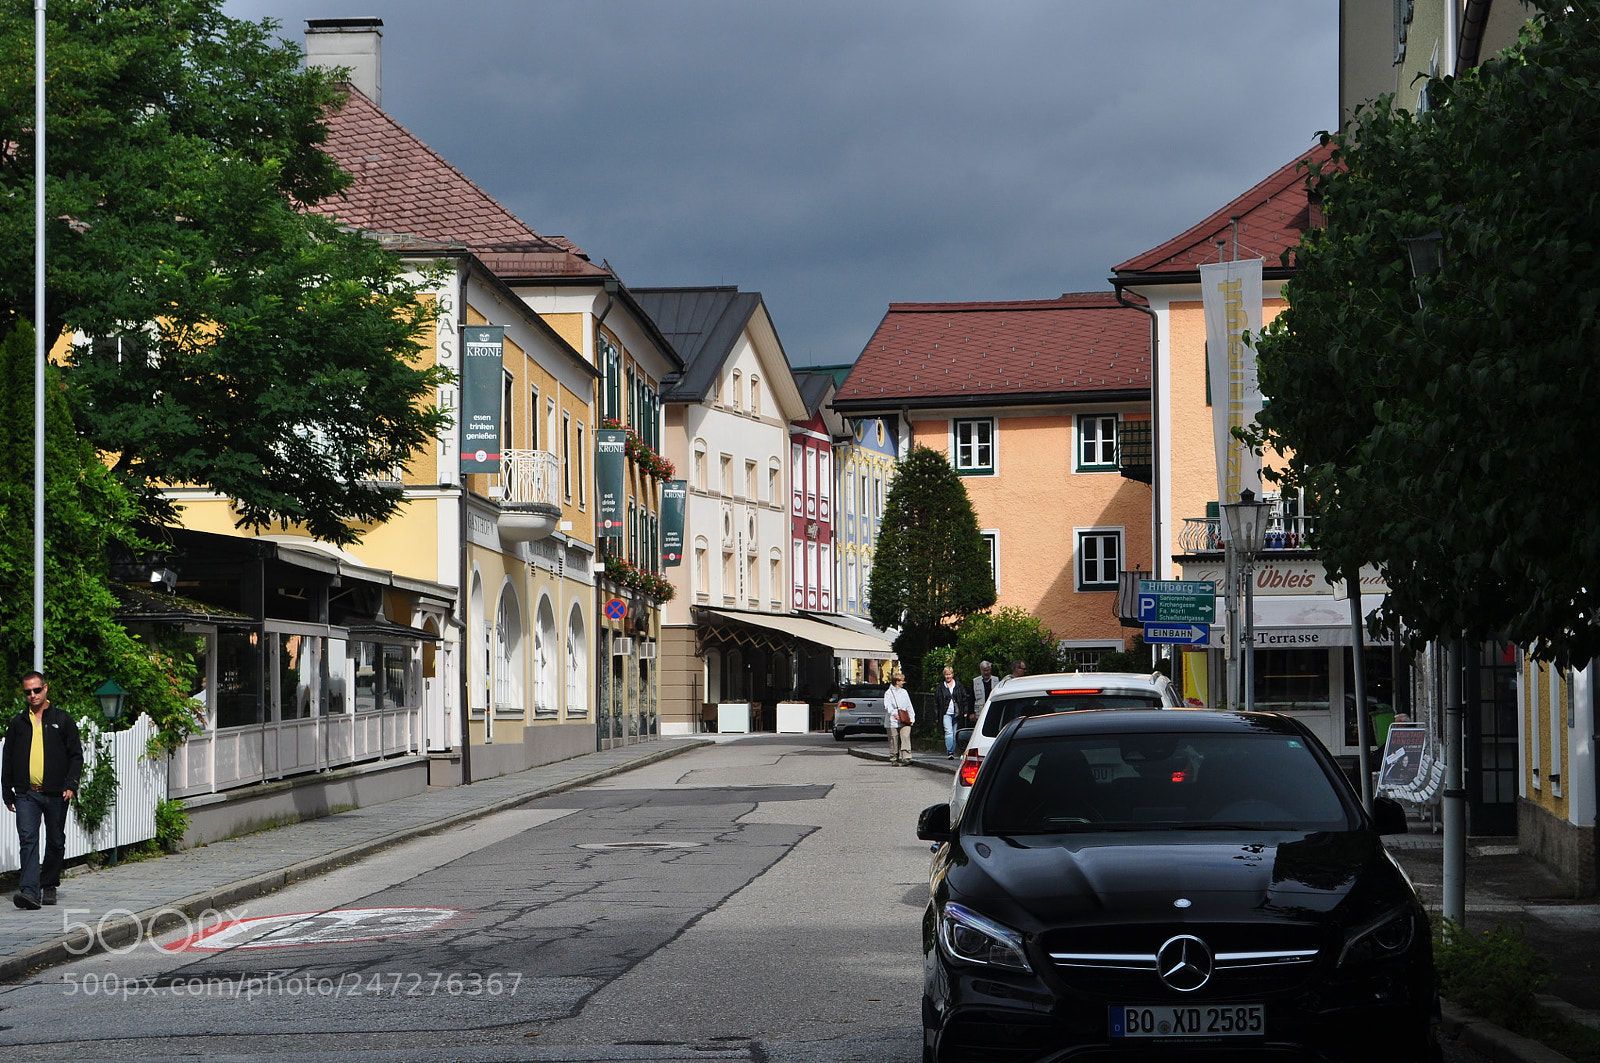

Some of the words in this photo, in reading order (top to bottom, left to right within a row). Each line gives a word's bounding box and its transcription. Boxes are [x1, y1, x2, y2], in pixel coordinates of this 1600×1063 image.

[466, 347, 502, 357] KRONE
[438, 293, 455, 456] GASHOF
[1217, 278, 1248, 503] alzkammergut
[466, 432, 497, 440] genießen
[598, 445, 624, 453] KRONE
[664, 491, 686, 499] KRONE
[1257, 565, 1316, 588] Übleis
[1149, 582, 1193, 593] Hilfberg
[1140, 597, 1156, 617] P
[1153, 629, 1193, 637] EINBAHN
[1126, 1009, 1155, 1033] BO
[1172, 1009, 1201, 1033] XD
[1207, 1007, 1261, 1033] 2585
